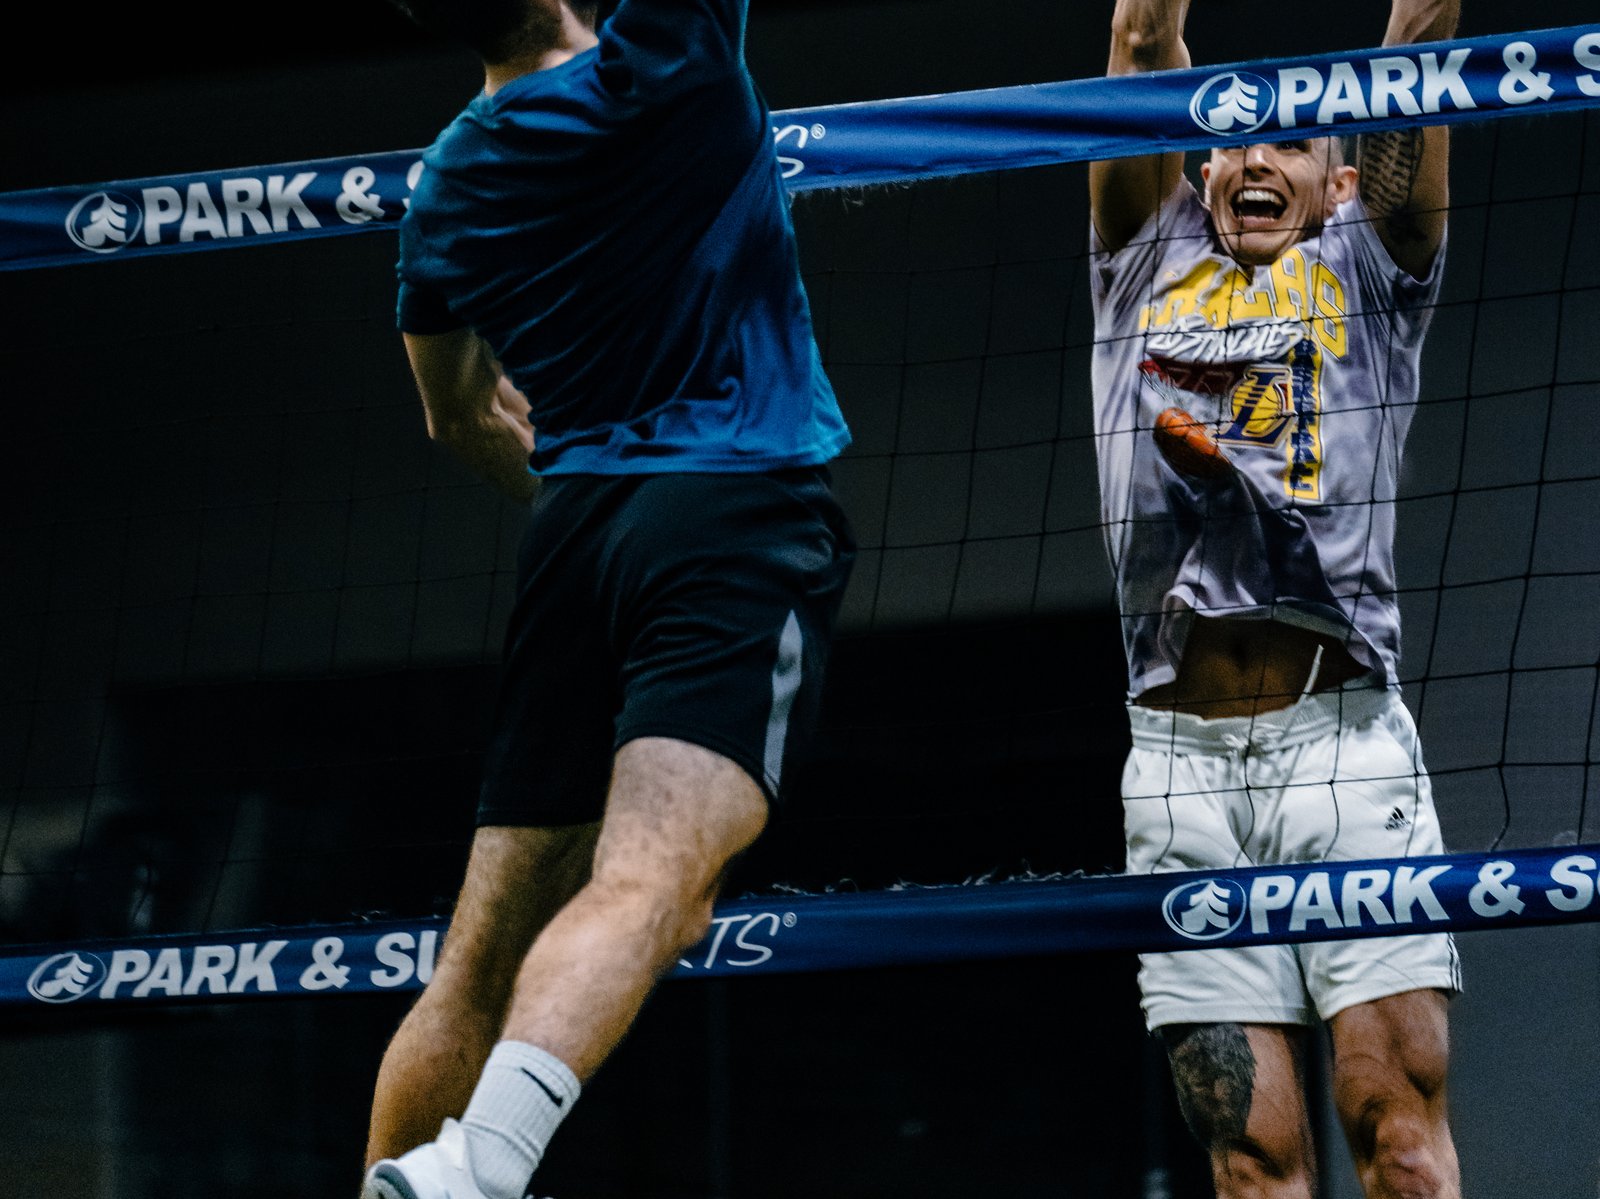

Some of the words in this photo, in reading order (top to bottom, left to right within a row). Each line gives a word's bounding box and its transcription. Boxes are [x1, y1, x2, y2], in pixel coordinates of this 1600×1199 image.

[1277, 48, 1478, 129] PARK
[1498, 41, 1556, 105] &
[142, 171, 323, 245] PARK
[335, 166, 386, 225] &
[1249, 864, 1454, 935] PARK
[1467, 860, 1527, 918] &
[100, 940, 290, 1000] PARK
[299, 936, 352, 992] &
